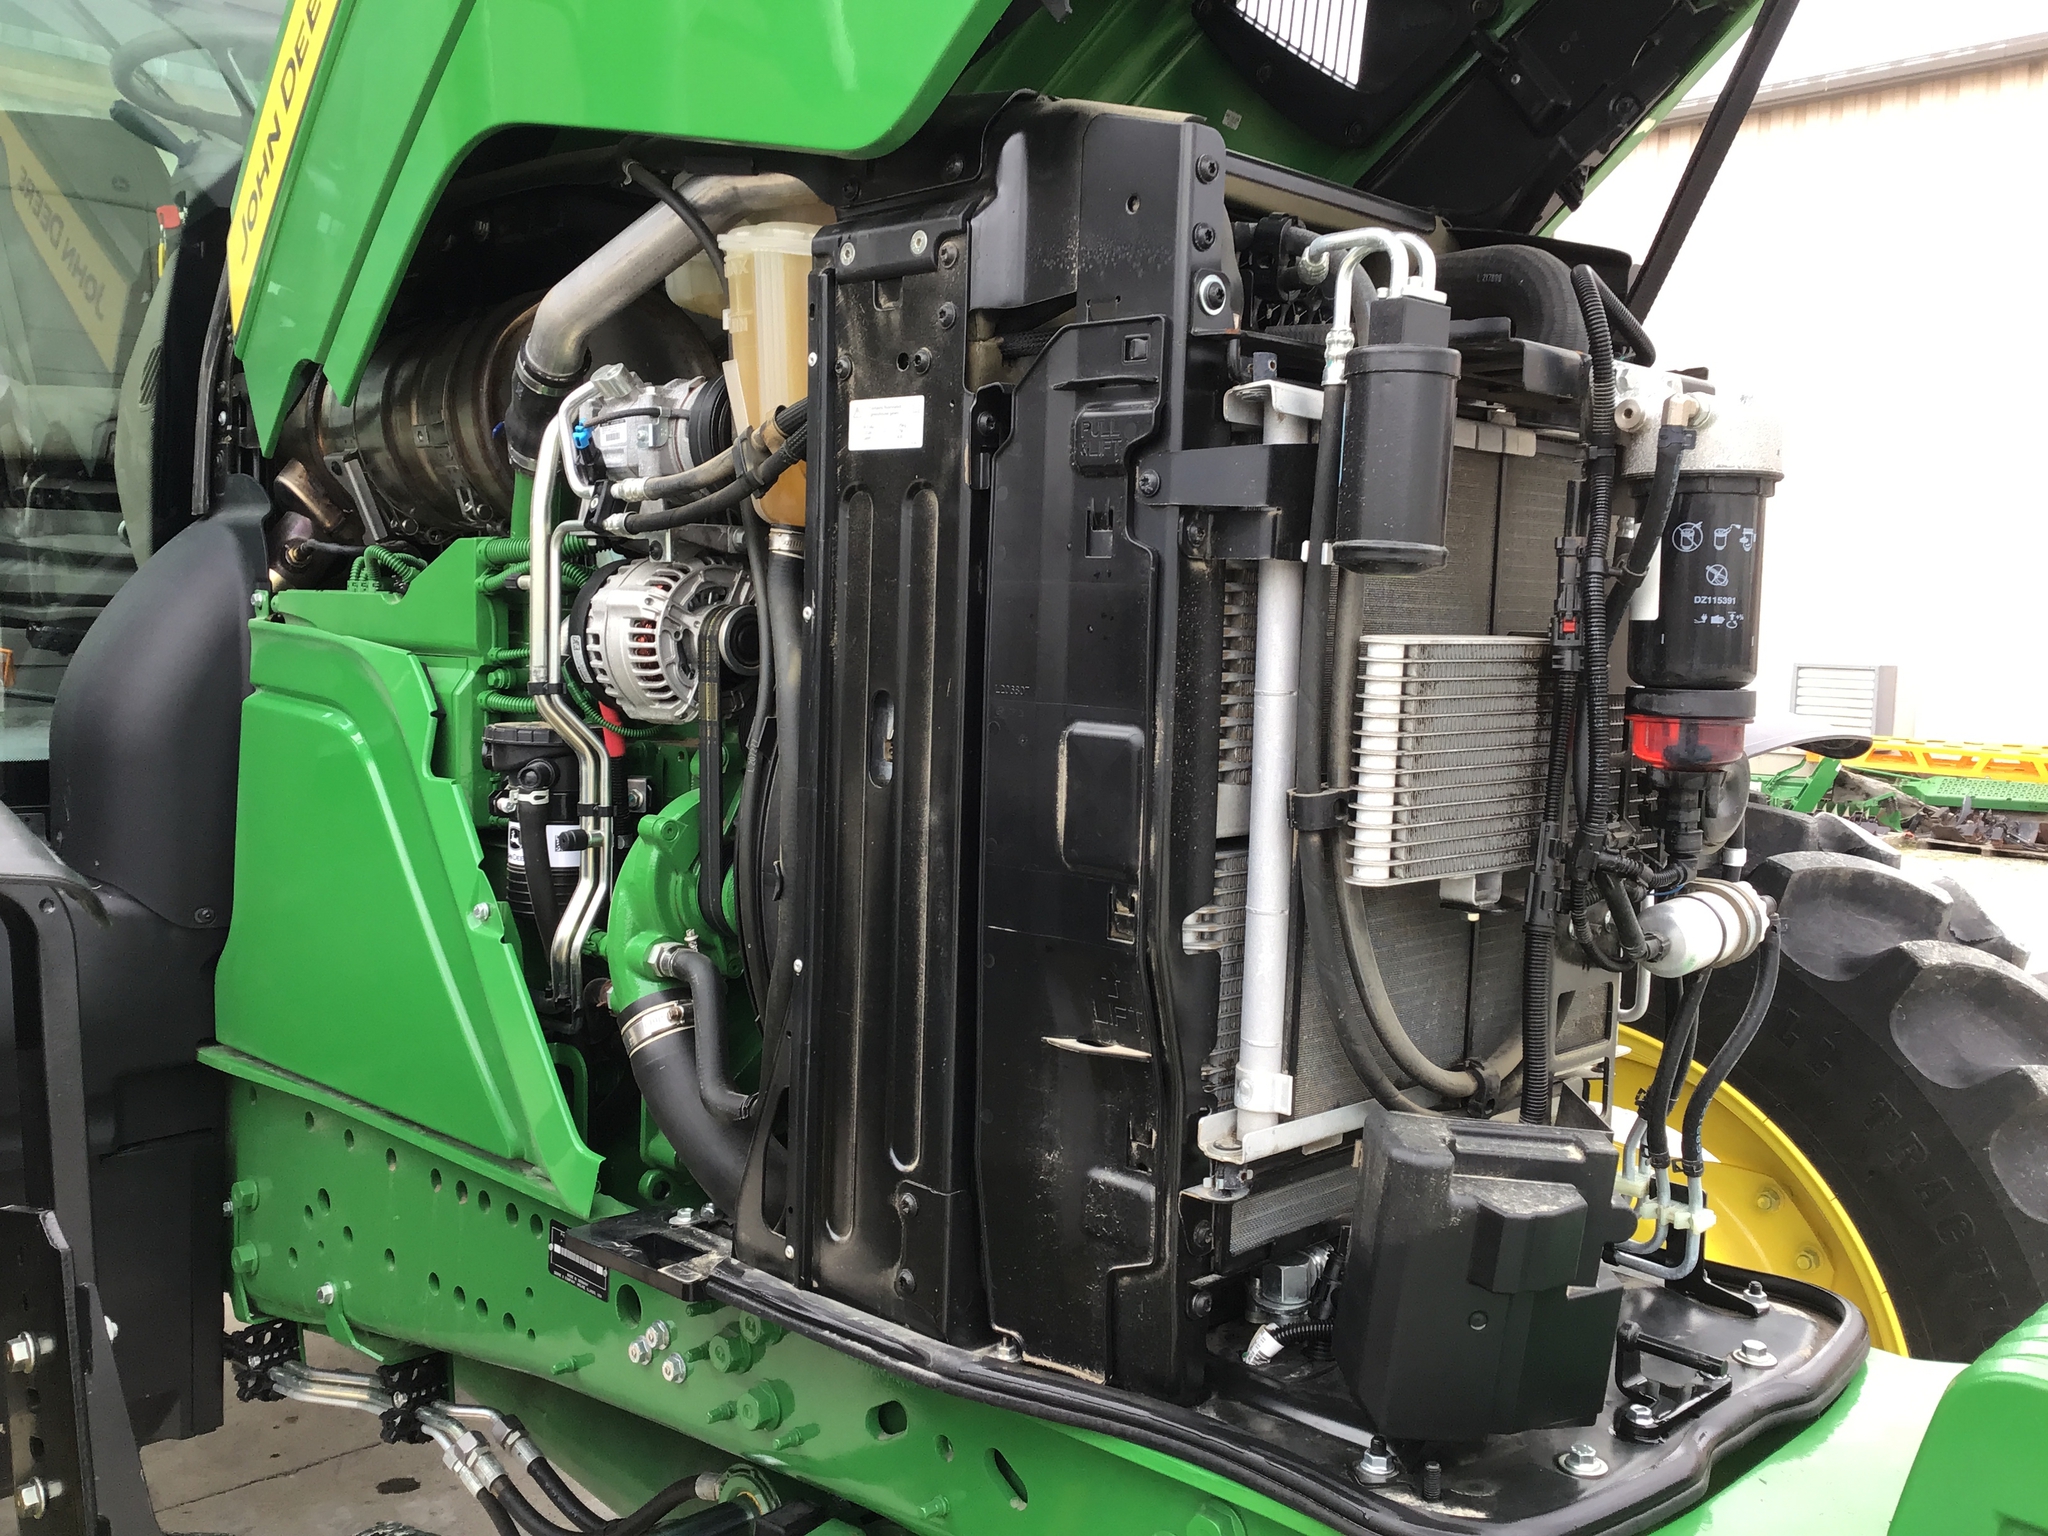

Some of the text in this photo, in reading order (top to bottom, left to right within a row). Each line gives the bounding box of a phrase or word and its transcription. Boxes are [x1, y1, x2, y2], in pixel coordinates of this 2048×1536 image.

[241, 110, 281, 265] JOHN
[1081, 419, 1121, 439] PULL
[1693, 595, 1736, 605] DZ115391
